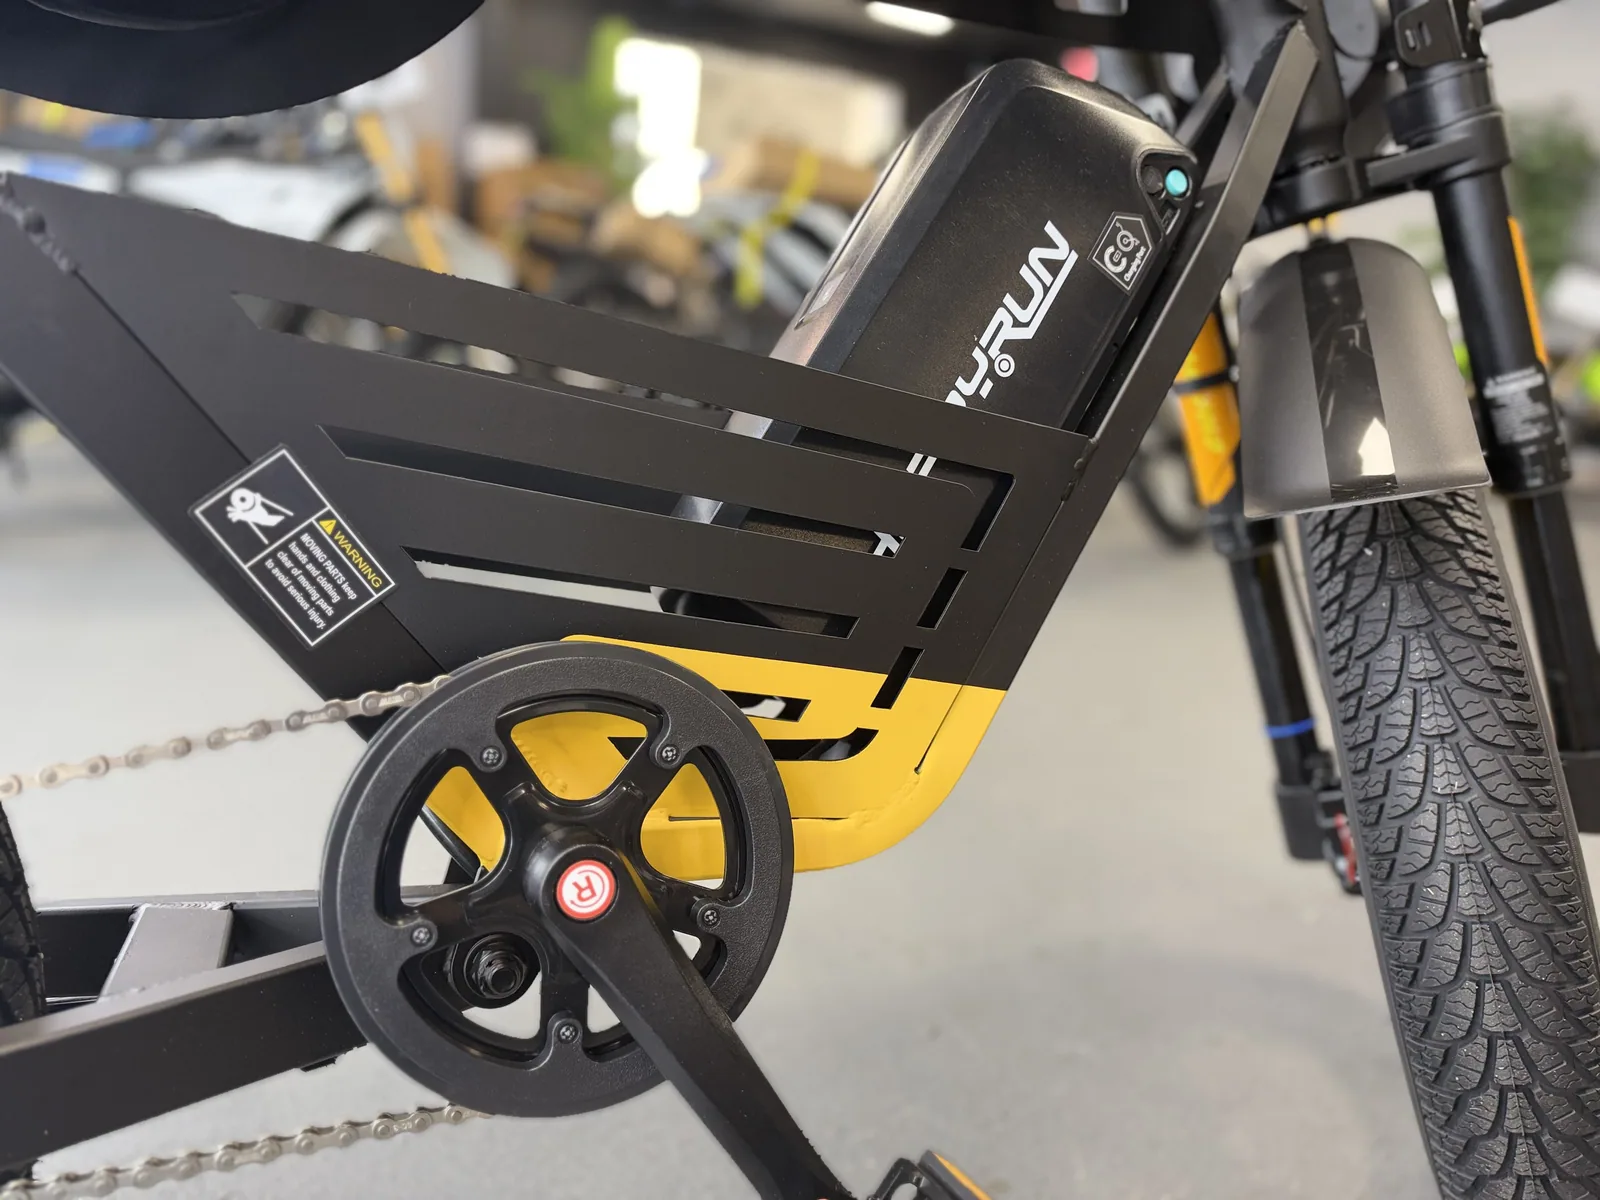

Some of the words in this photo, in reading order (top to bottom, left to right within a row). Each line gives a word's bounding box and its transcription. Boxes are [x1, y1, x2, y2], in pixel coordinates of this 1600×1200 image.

[1124, 257, 1141, 281] Charging
[1136, 246, 1146, 259] Port
[277, 551, 294, 568] clear
[291, 567, 302, 576] of
[297, 572, 319, 601] moving
[316, 597, 334, 616] parts
[289, 541, 308, 564] hands
[306, 563, 320, 577] and
[316, 573, 340, 603] clothing
[300, 533, 327, 562] MOVING
[323, 560, 345, 584] PARTS
[342, 582, 357, 600] keep
[334, 531, 382, 588] WARNING
[265, 559, 274, 568] to
[272, 567, 291, 587] avoid
[287, 585, 310, 610] serious
[307, 607, 327, 629] injury.
